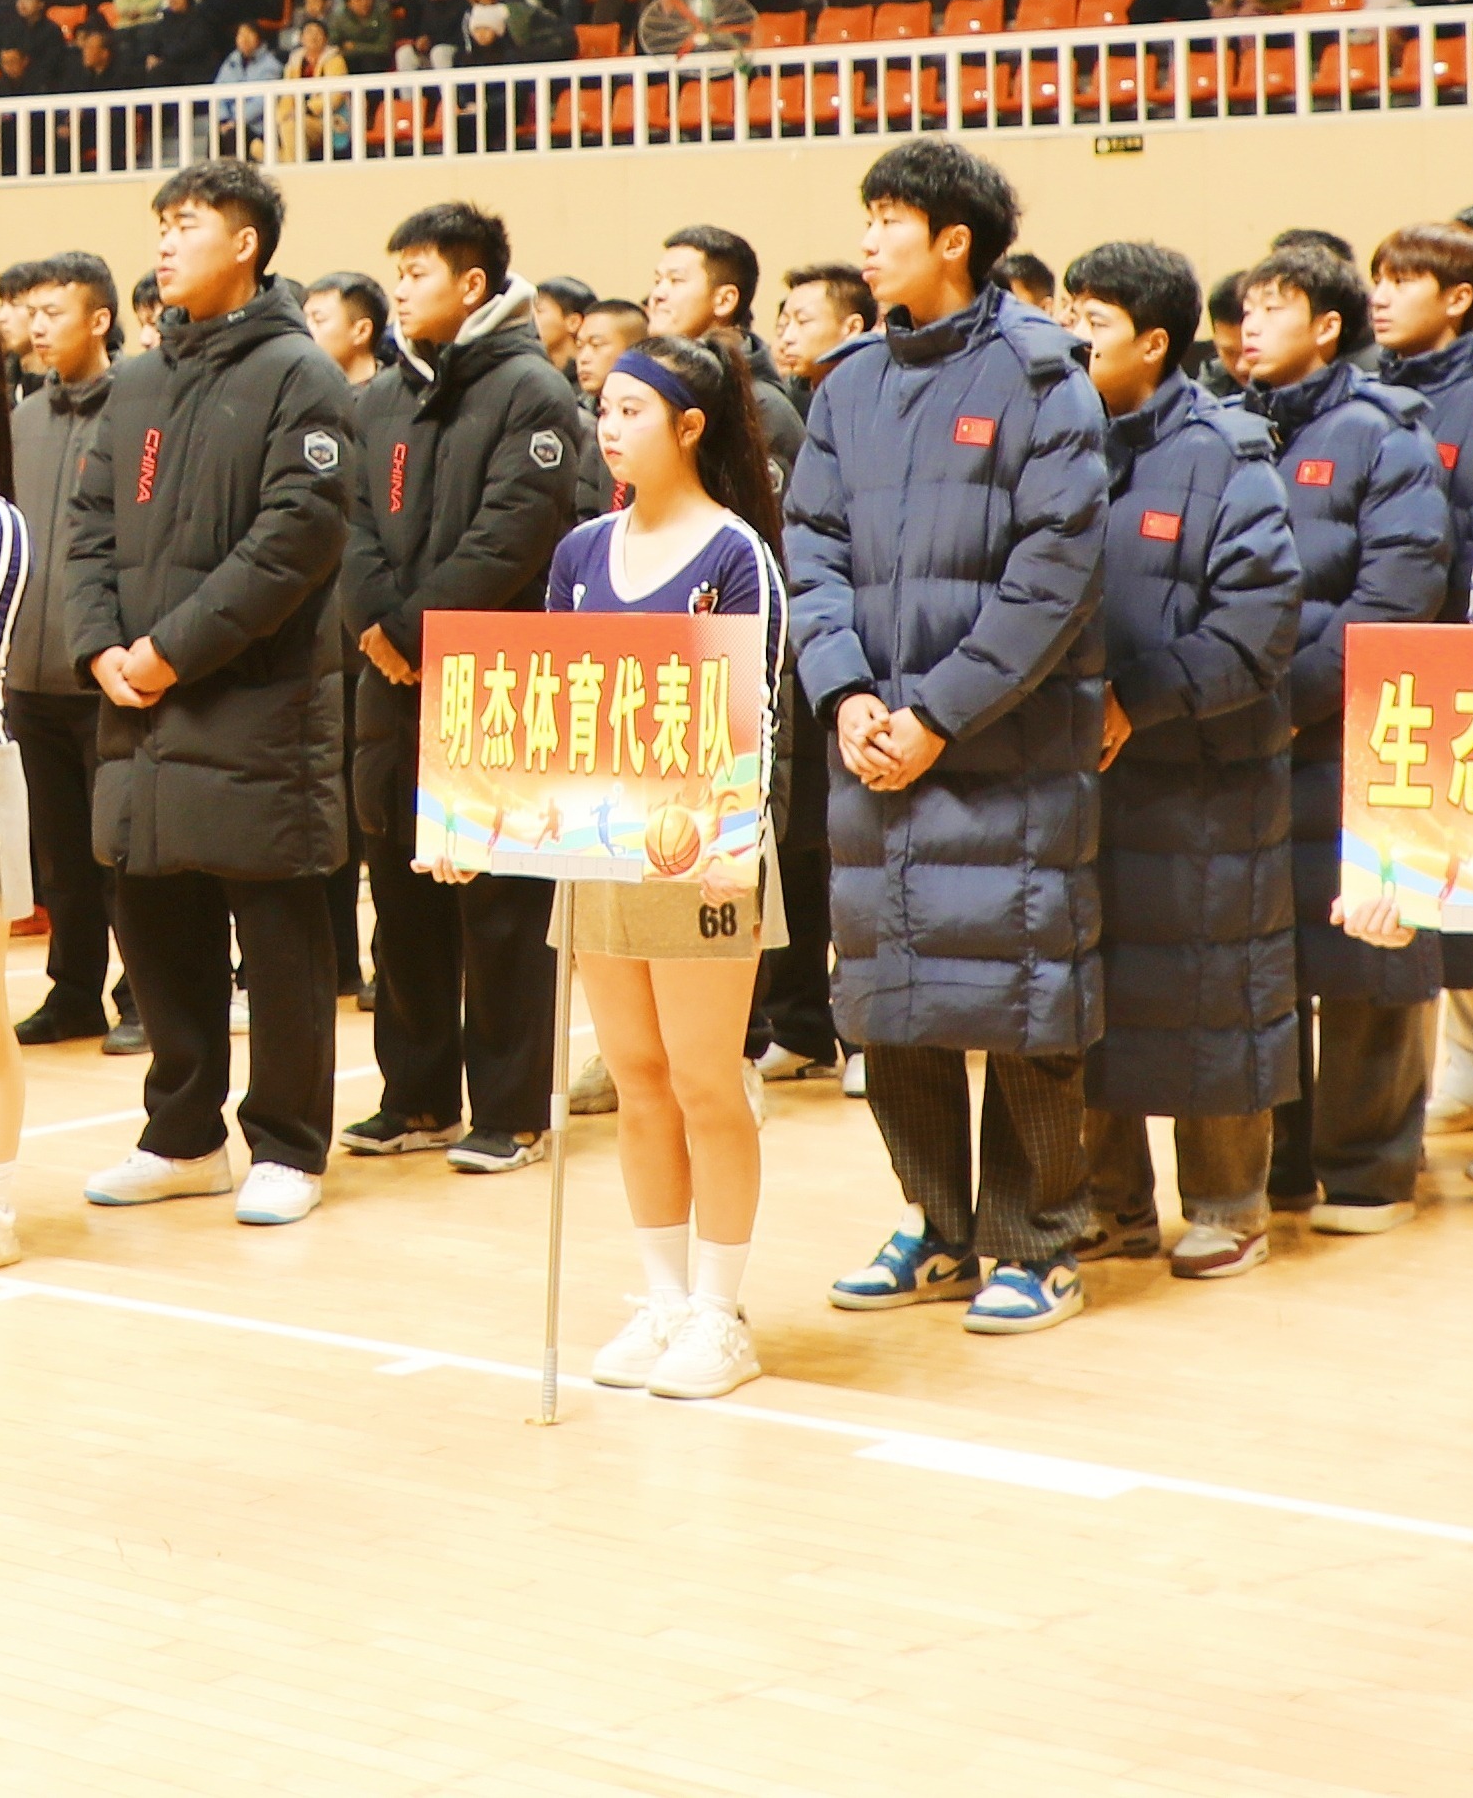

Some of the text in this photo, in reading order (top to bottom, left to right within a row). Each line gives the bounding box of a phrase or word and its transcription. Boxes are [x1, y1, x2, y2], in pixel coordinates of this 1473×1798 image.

[136, 428, 163, 503] CHINA
[390, 443, 408, 513] CHINA
[439, 650, 736, 781] 明杰体育代表队
[698, 902, 738, 940] 68
